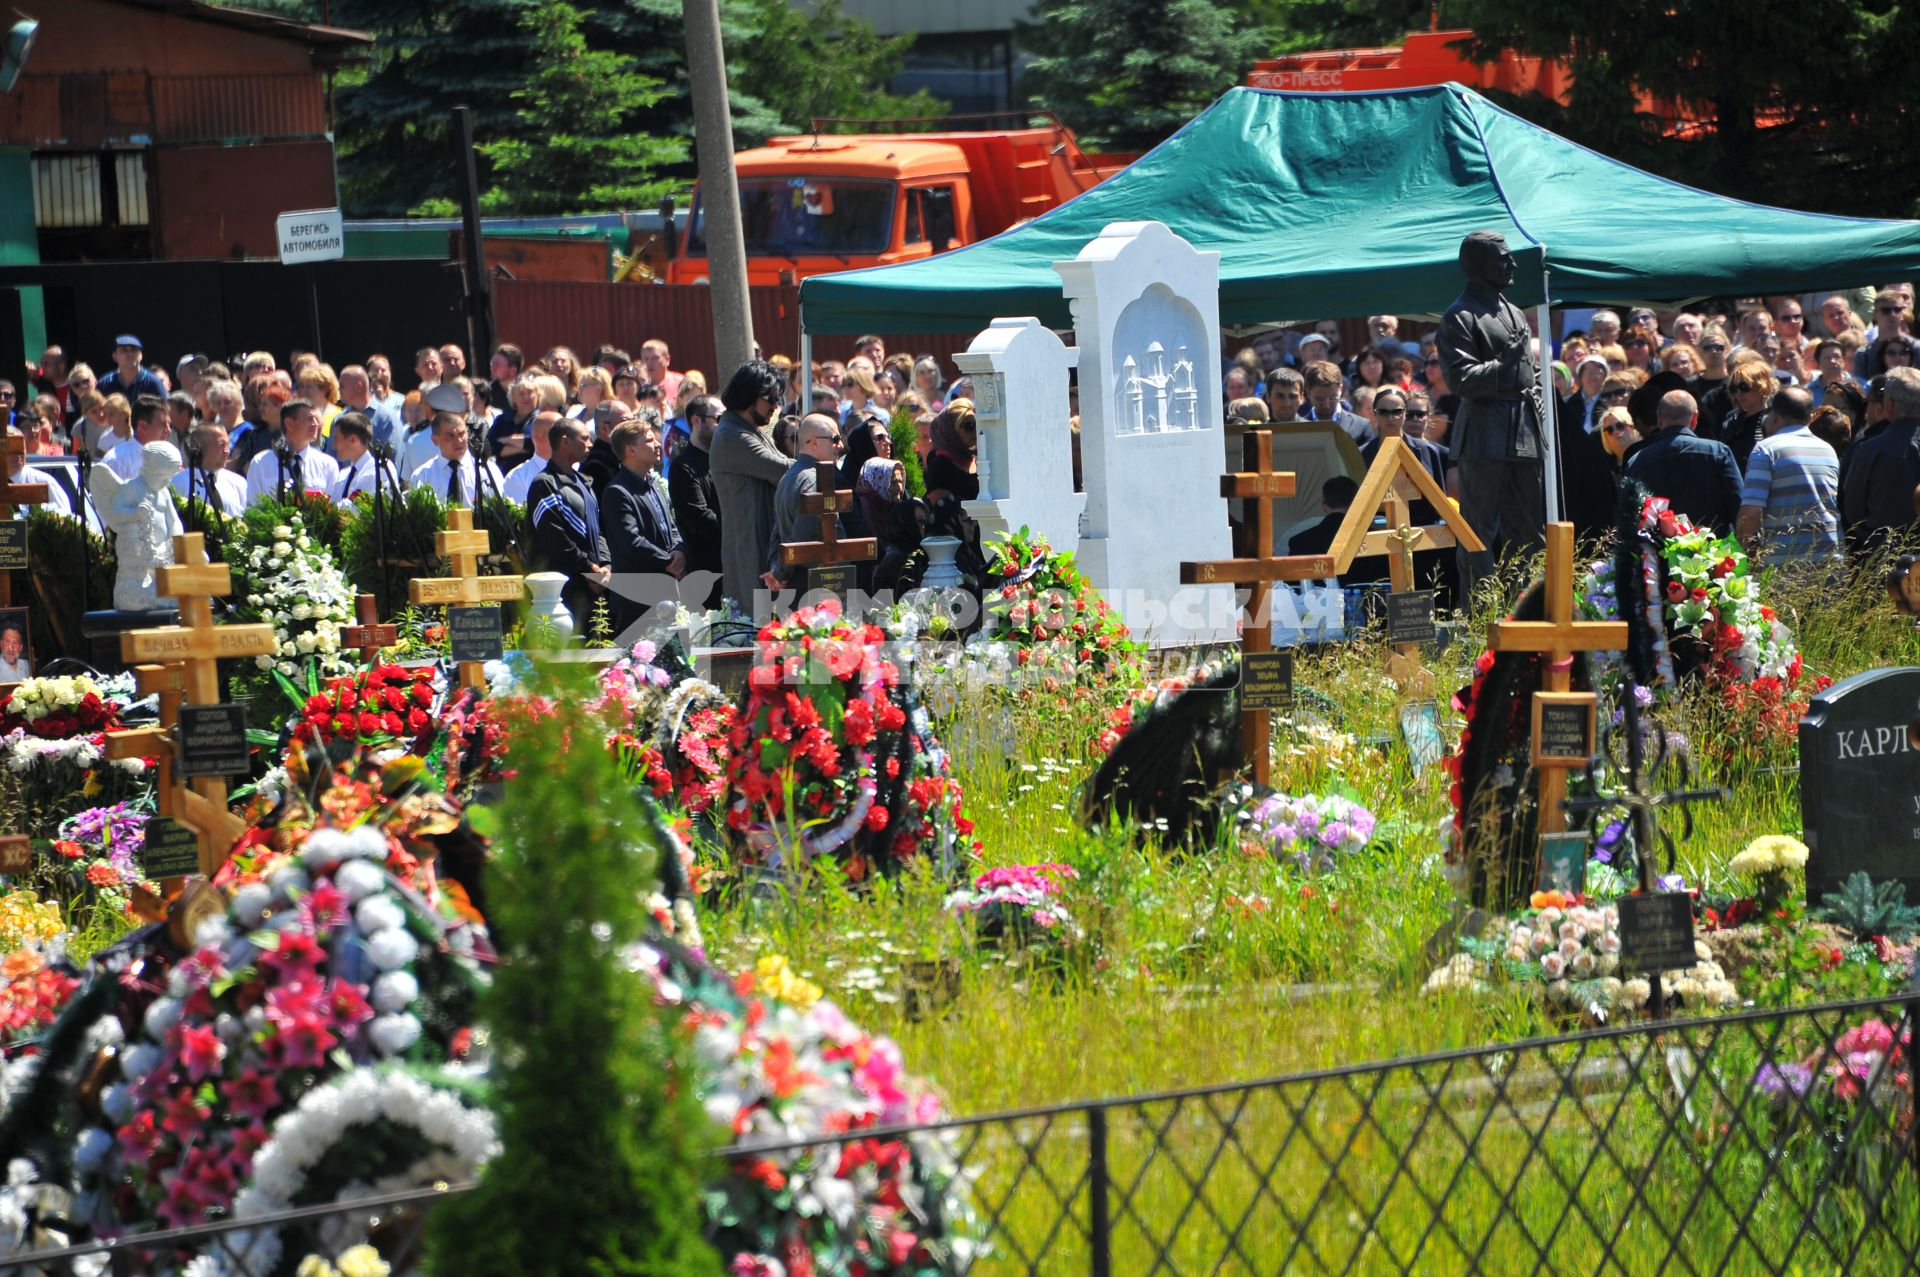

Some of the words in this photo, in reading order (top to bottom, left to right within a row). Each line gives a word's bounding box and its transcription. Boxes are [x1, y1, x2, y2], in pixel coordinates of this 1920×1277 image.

[290, 223, 330, 237] БЕРЕГИСЬ
[283, 237, 341, 254] АВТОМОБИЛЯ
[1837, 724, 1910, 759] КАРЛ
